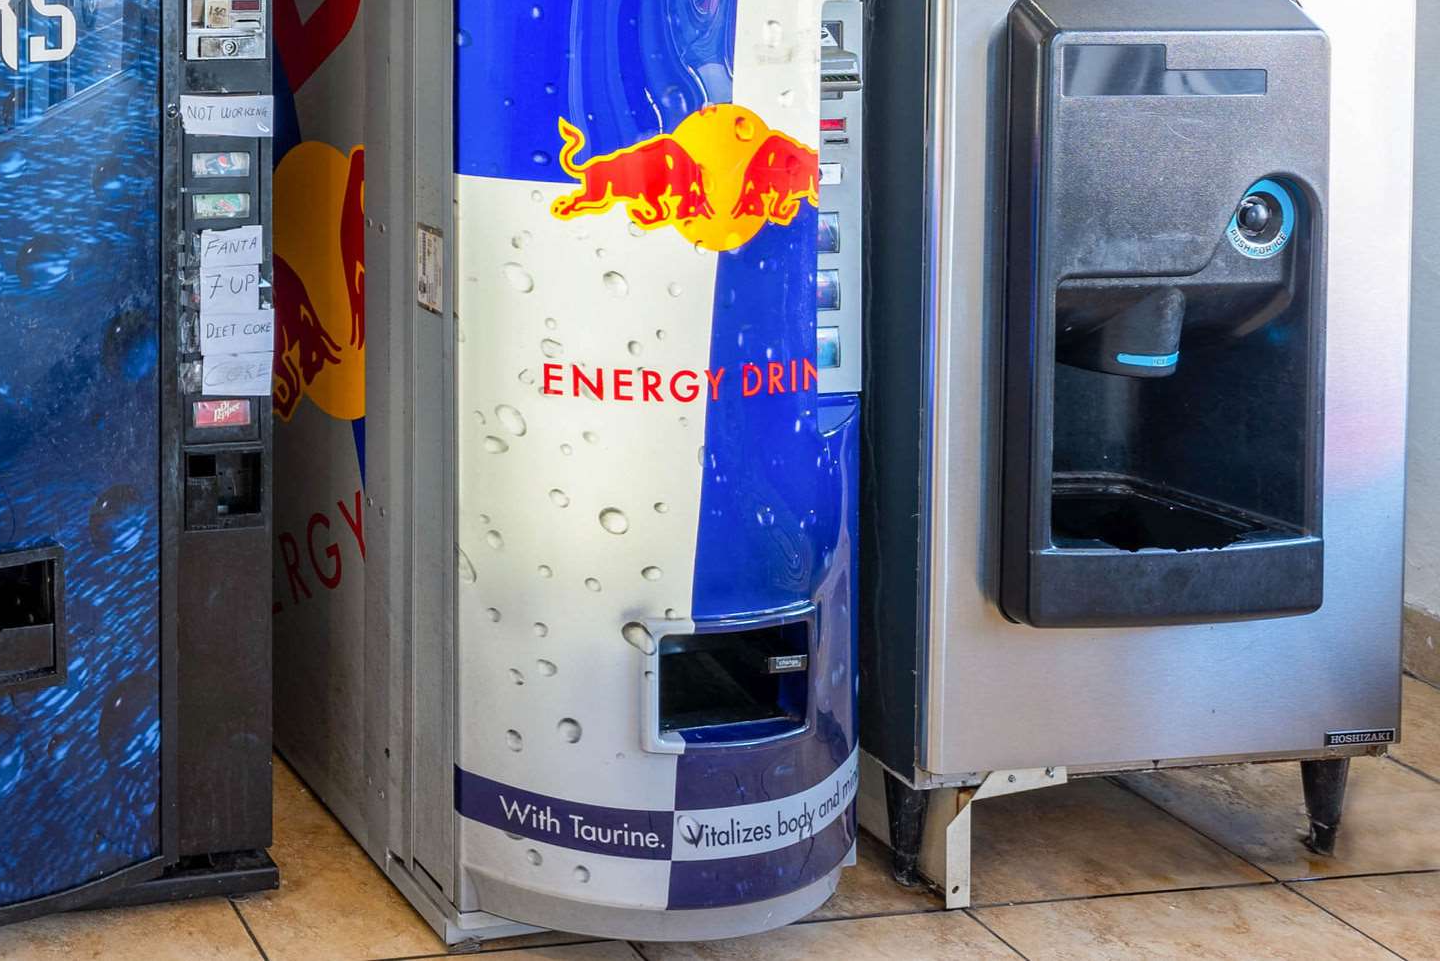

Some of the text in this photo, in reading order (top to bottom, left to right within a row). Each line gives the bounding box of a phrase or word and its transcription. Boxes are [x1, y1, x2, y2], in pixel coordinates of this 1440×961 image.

[187, 105, 270, 121] NOT WORKING
[204, 236, 257, 256] FANTA
[1230, 229, 1286, 254] PUSH FOR ICE
[206, 273, 256, 299] 7 UP
[206, 322, 272, 339] DIET COKE
[544, 362, 725, 402] ENERGY
[214, 402, 241, 423] Pepper
[272, 490, 366, 614] RGY
[1330, 732, 1391, 744] HOSHIZAKI
[500, 795, 561, 834] With
[569, 815, 665, 849] Taurine.
[687, 819, 772, 848] Vitalizes
[778, 801, 816, 836] body
[818, 781, 840, 818] and
